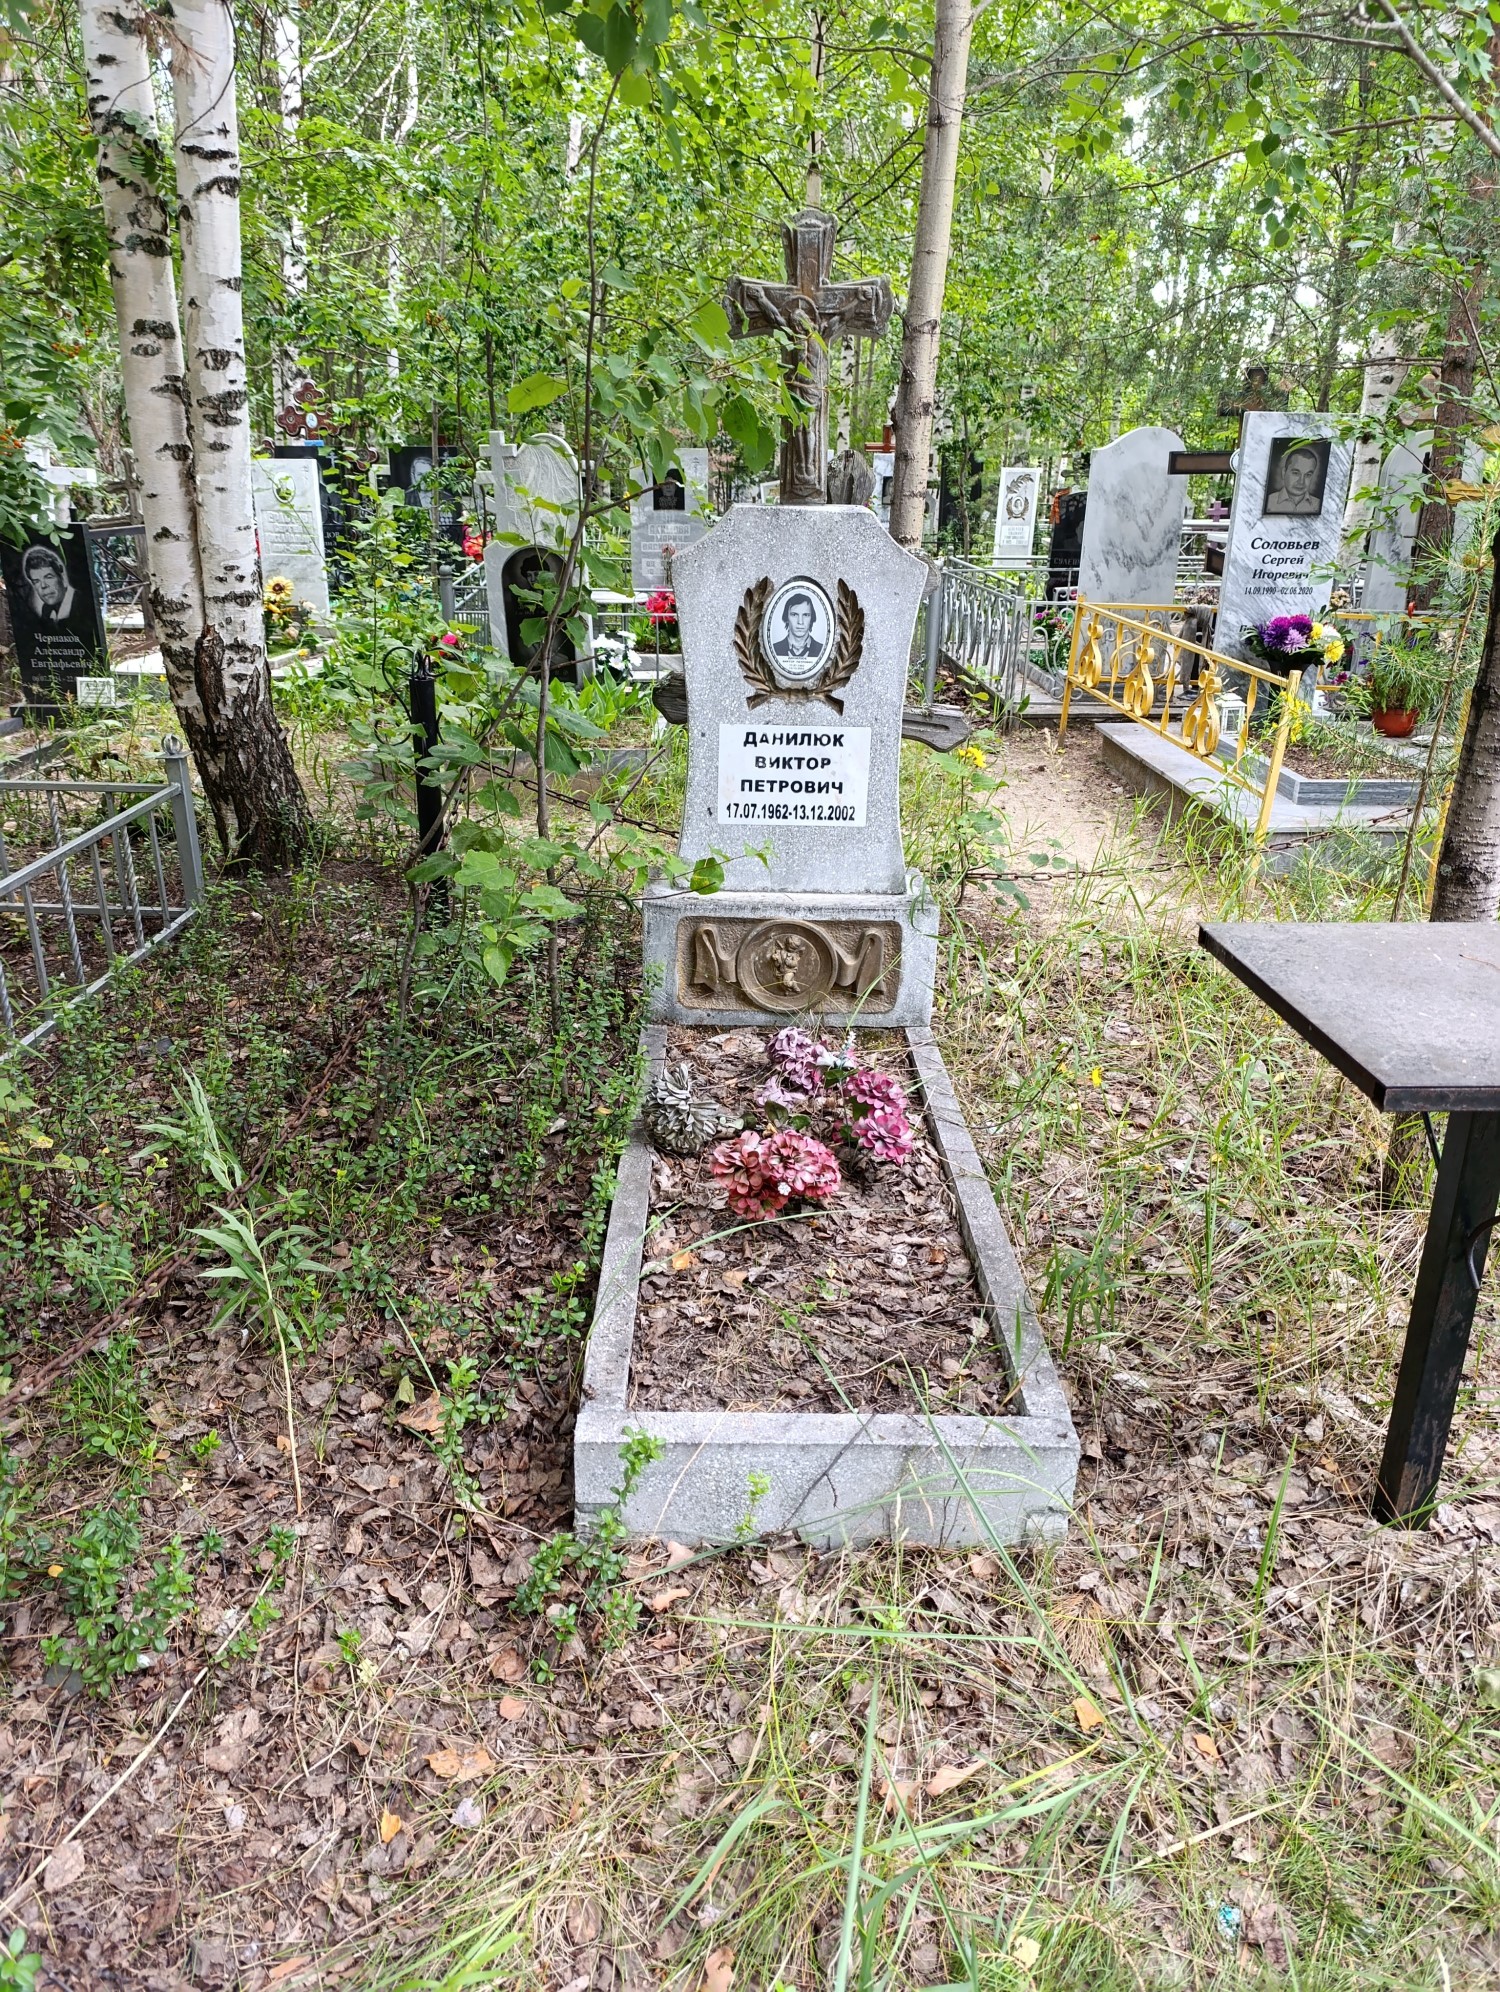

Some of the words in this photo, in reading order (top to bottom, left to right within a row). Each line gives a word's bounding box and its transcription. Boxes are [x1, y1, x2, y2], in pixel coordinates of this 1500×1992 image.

[1251, 538, 1320, 549] Соловьев
[1261, 554, 1304, 566] Сергей
[1251, 569, 1309, 581] Игоревич
[34, 633, 79, 644] Чернаков
[34, 647, 85, 657] Александр
[30, 659, 92, 670] Евграфьевич
[743, 732, 844, 747] ДАНИЛЮК
[755, 756, 831, 770] ВИКТОР
[740, 779, 843, 794] ПЕТРОВИЧ
[726, 803, 856, 821] 17.07.1962-13.12.2002
